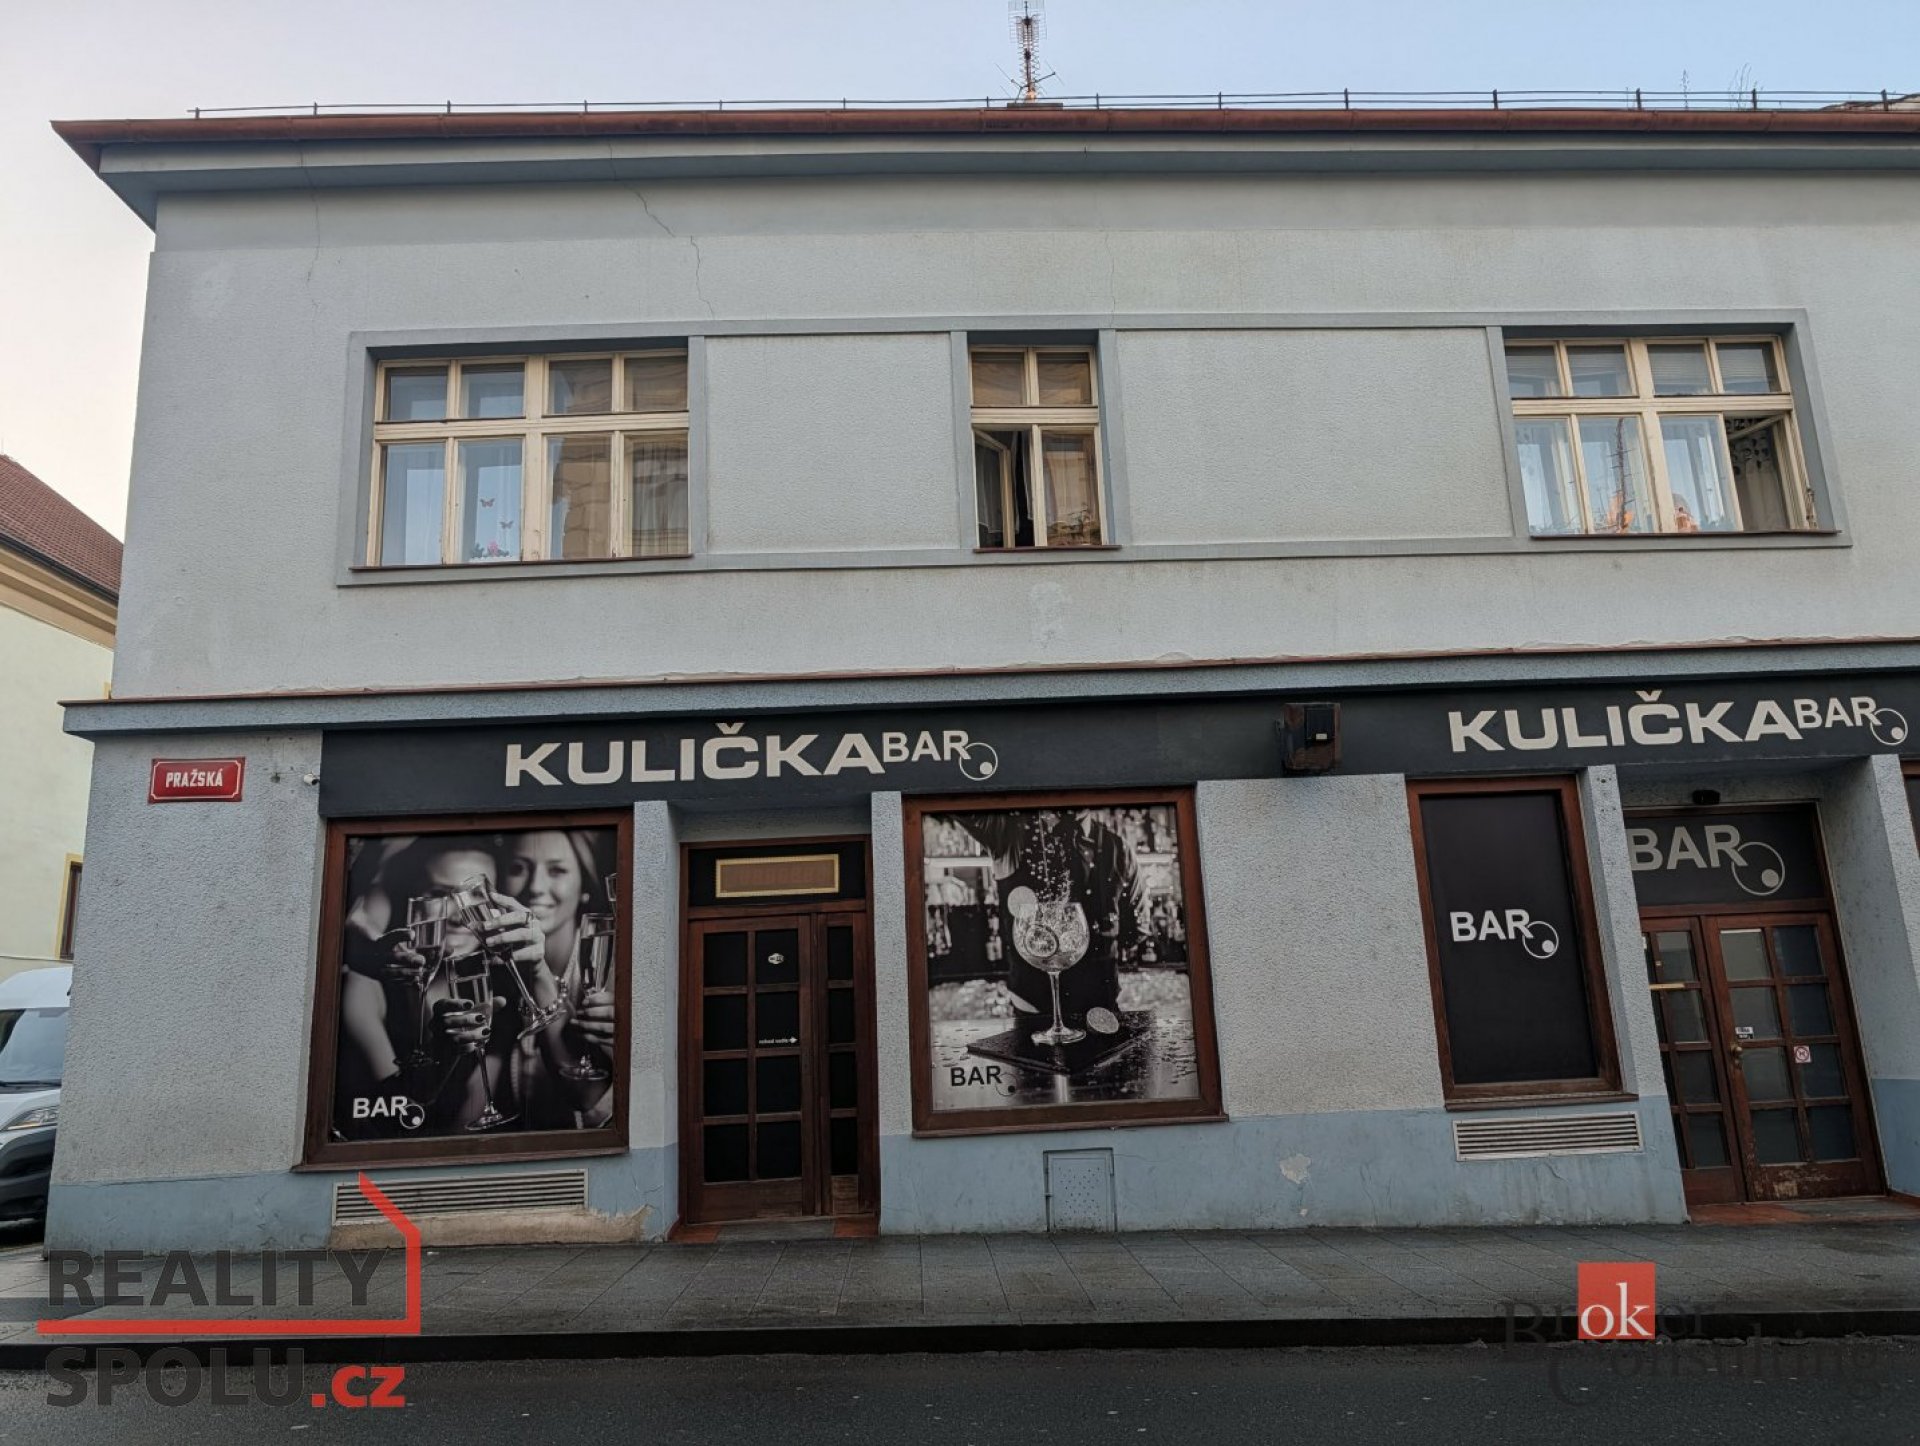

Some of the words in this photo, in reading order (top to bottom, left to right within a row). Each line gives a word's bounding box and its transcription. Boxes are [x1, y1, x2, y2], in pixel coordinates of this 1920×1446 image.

[1448, 690, 1803, 752] KULIČKA
[1795, 696, 1883, 730] BAR
[505, 722, 885, 787] KULIČKA
[882, 730, 973, 763] BAR
[165, 768, 223, 788] PRAŽSKÁ
[1625, 825, 1748, 871] BAR
[1450, 909, 1534, 942] BAR
[951, 1066, 1002, 1086] BAR
[353, 1096, 408, 1118] BAR
